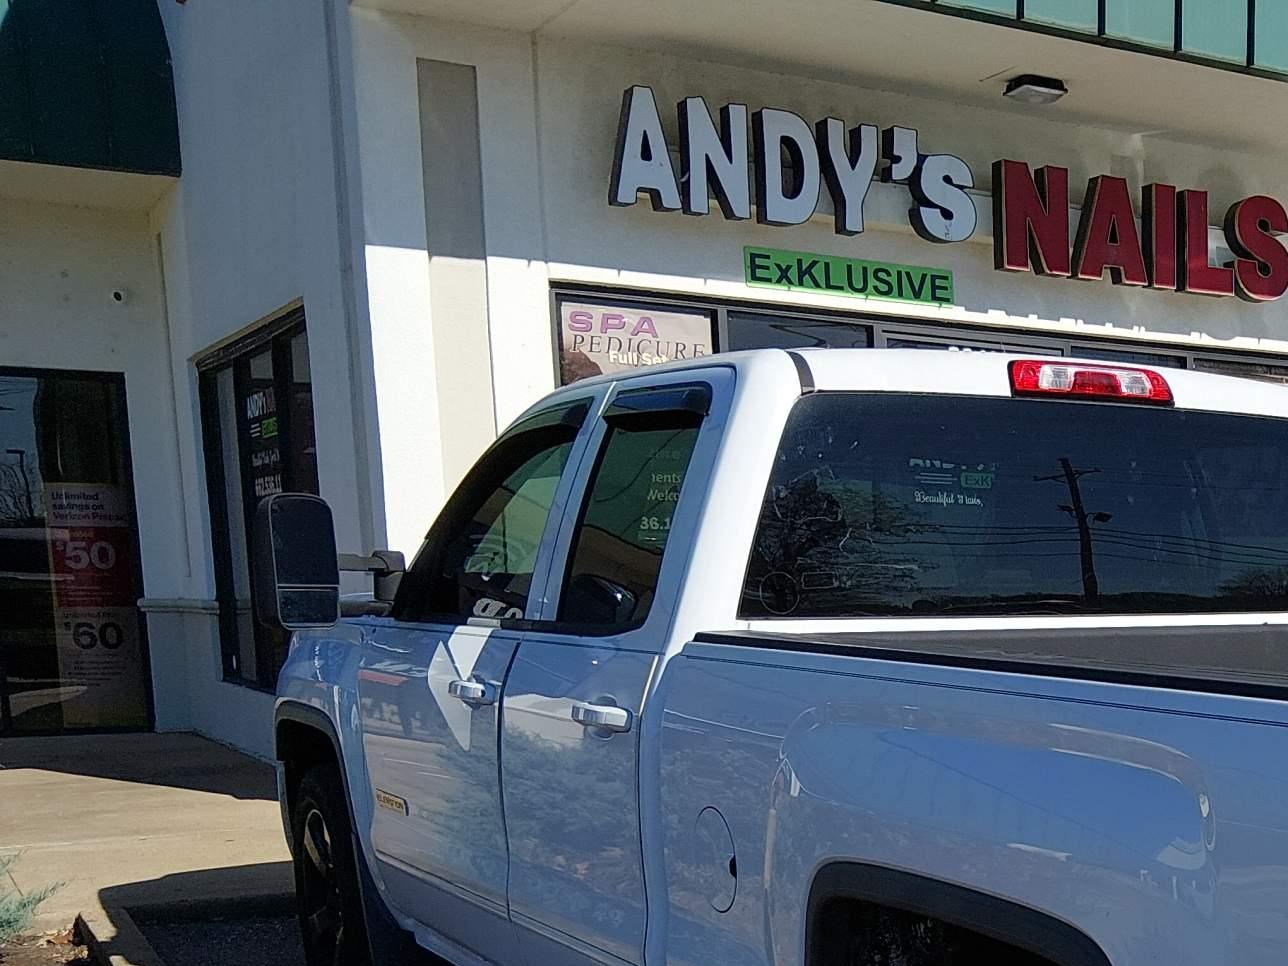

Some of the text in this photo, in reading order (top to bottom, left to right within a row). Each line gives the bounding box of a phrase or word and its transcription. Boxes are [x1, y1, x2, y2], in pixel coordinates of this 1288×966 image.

[609, 84, 977, 243] ANDY'S
[568, 310, 658, 339] SPA
[609, 350, 639, 367] Full
